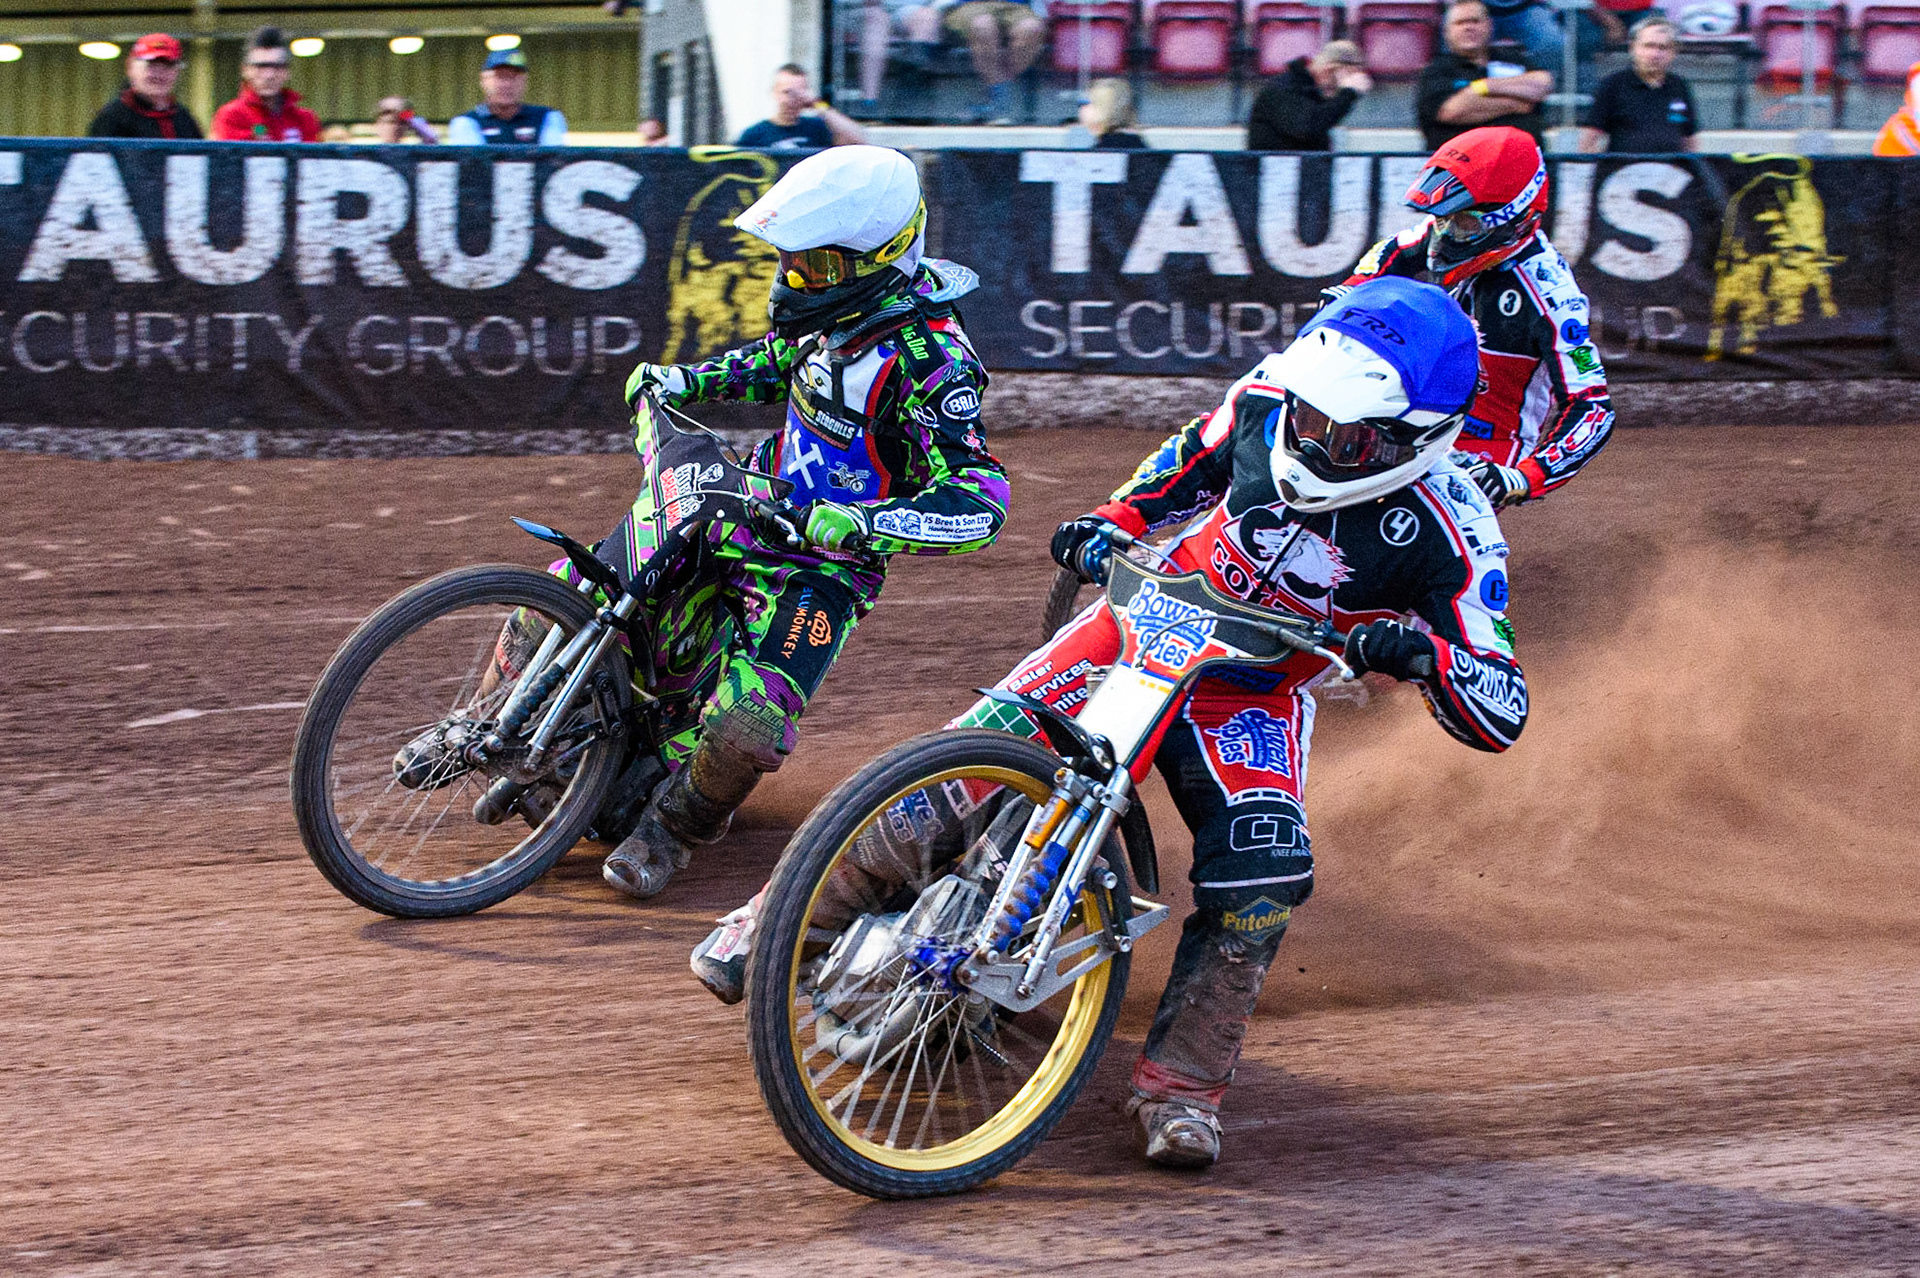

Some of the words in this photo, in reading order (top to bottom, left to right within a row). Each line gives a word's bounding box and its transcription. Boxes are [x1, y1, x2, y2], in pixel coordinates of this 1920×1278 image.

[0, 152, 647, 290] AURUS
[1020, 152, 1693, 280] TAUS
[0, 310, 324, 372] CURITY
[349, 314, 642, 376] GROUP
[1020, 299, 1318, 358] SECURI
[1342, 308, 1406, 346] FRP
[815, 409, 856, 440] SEAGULLS
[963, 518, 976, 526] Son
[977, 515, 991, 524] LTD
[1130, 580, 1216, 636] Bowen
[1023, 659, 1094, 700] ervices
[1222, 908, 1290, 932] Putolin
